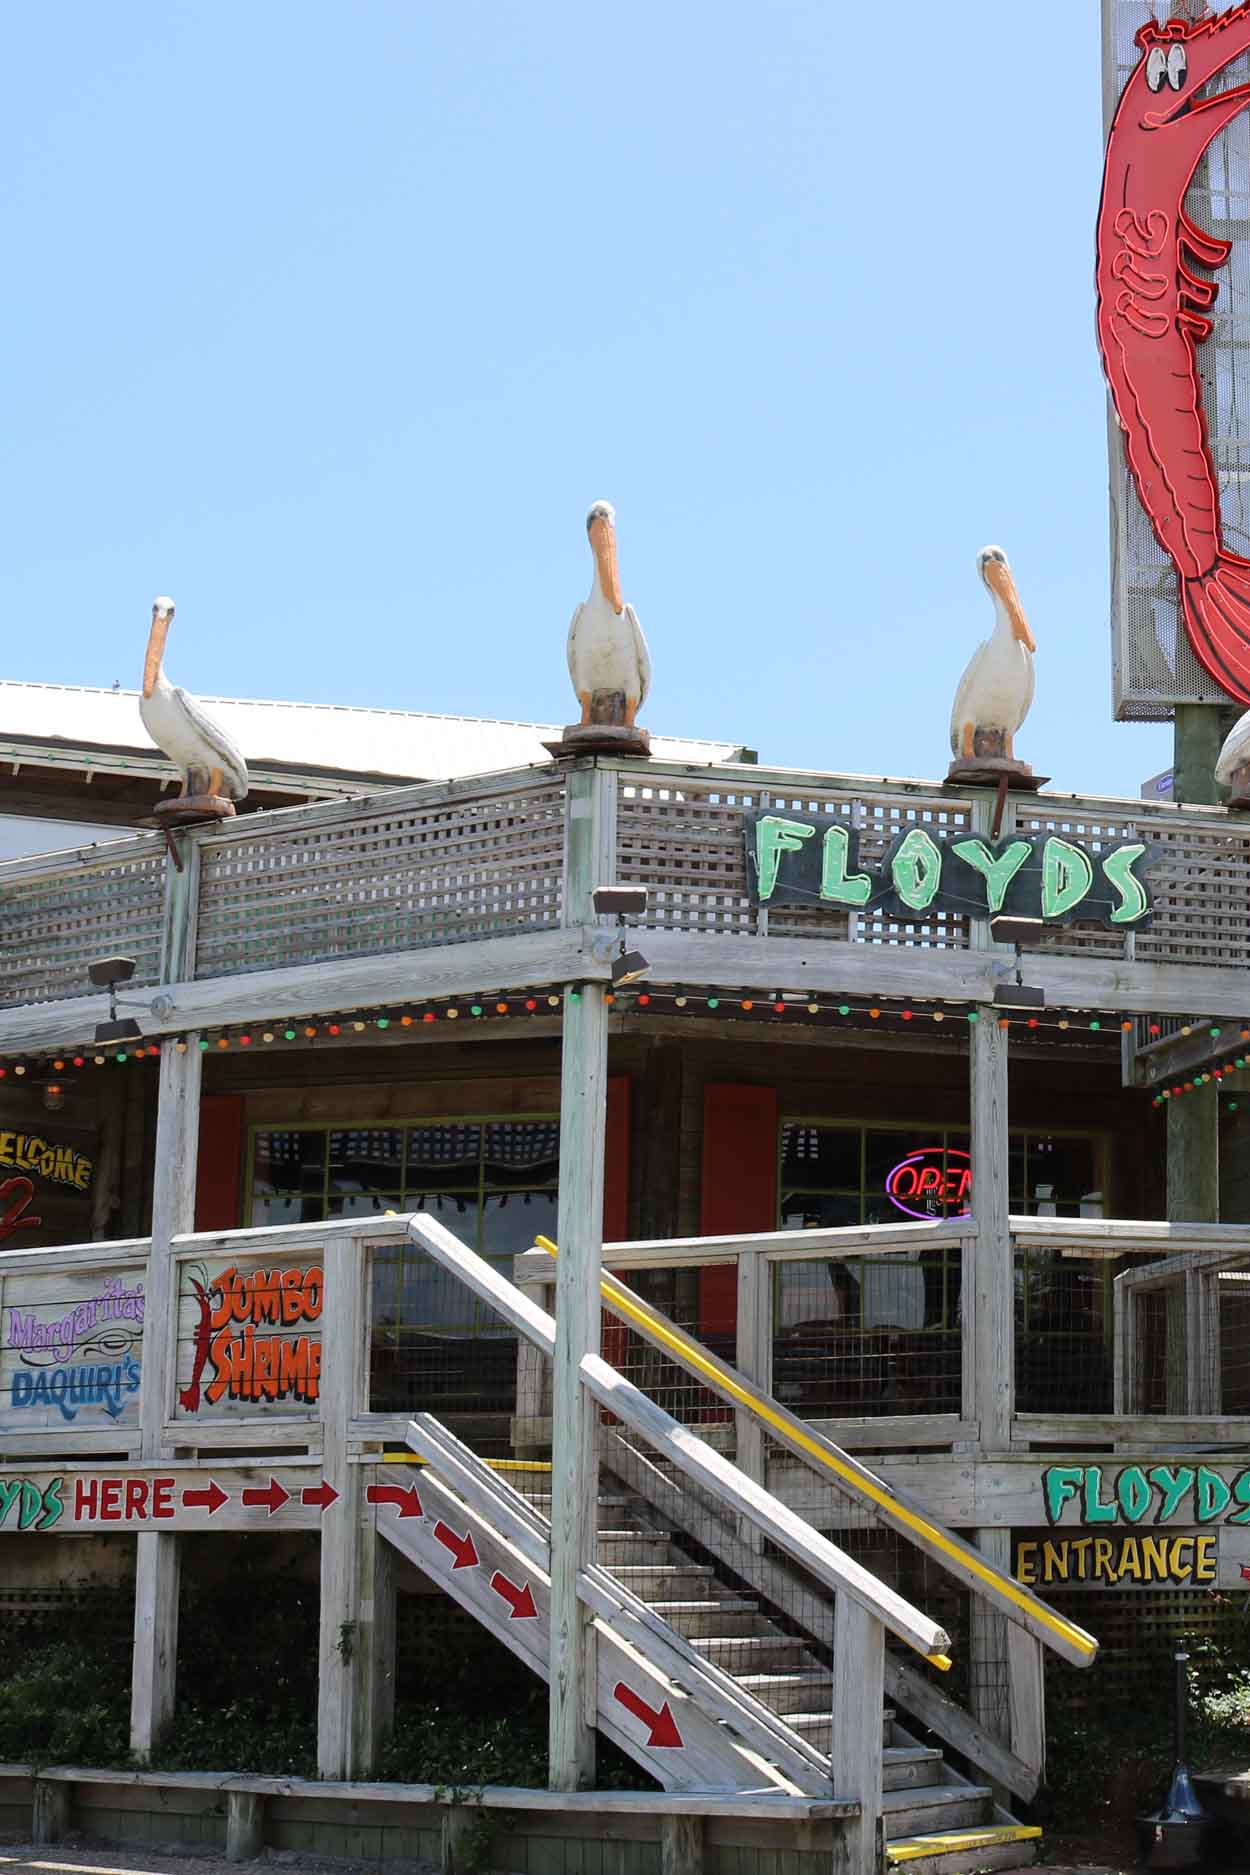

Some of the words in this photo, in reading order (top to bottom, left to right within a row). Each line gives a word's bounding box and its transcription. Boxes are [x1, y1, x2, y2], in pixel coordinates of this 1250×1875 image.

[755, 815, 1147, 923] FLOYDS
[0, 1131, 93, 1191] ELCOME
[8, 1277, 145, 1362] Margarita's
[211, 1266, 324, 1327] JUMBO
[11, 1353, 141, 1421] DAQUIRI'S
[204, 1323, 322, 1405] SHRIMP
[0, 1477, 64, 1530] YDS
[74, 1478, 176, 1521] HERE
[1015, 1536, 1217, 1585] ENTRANCE
